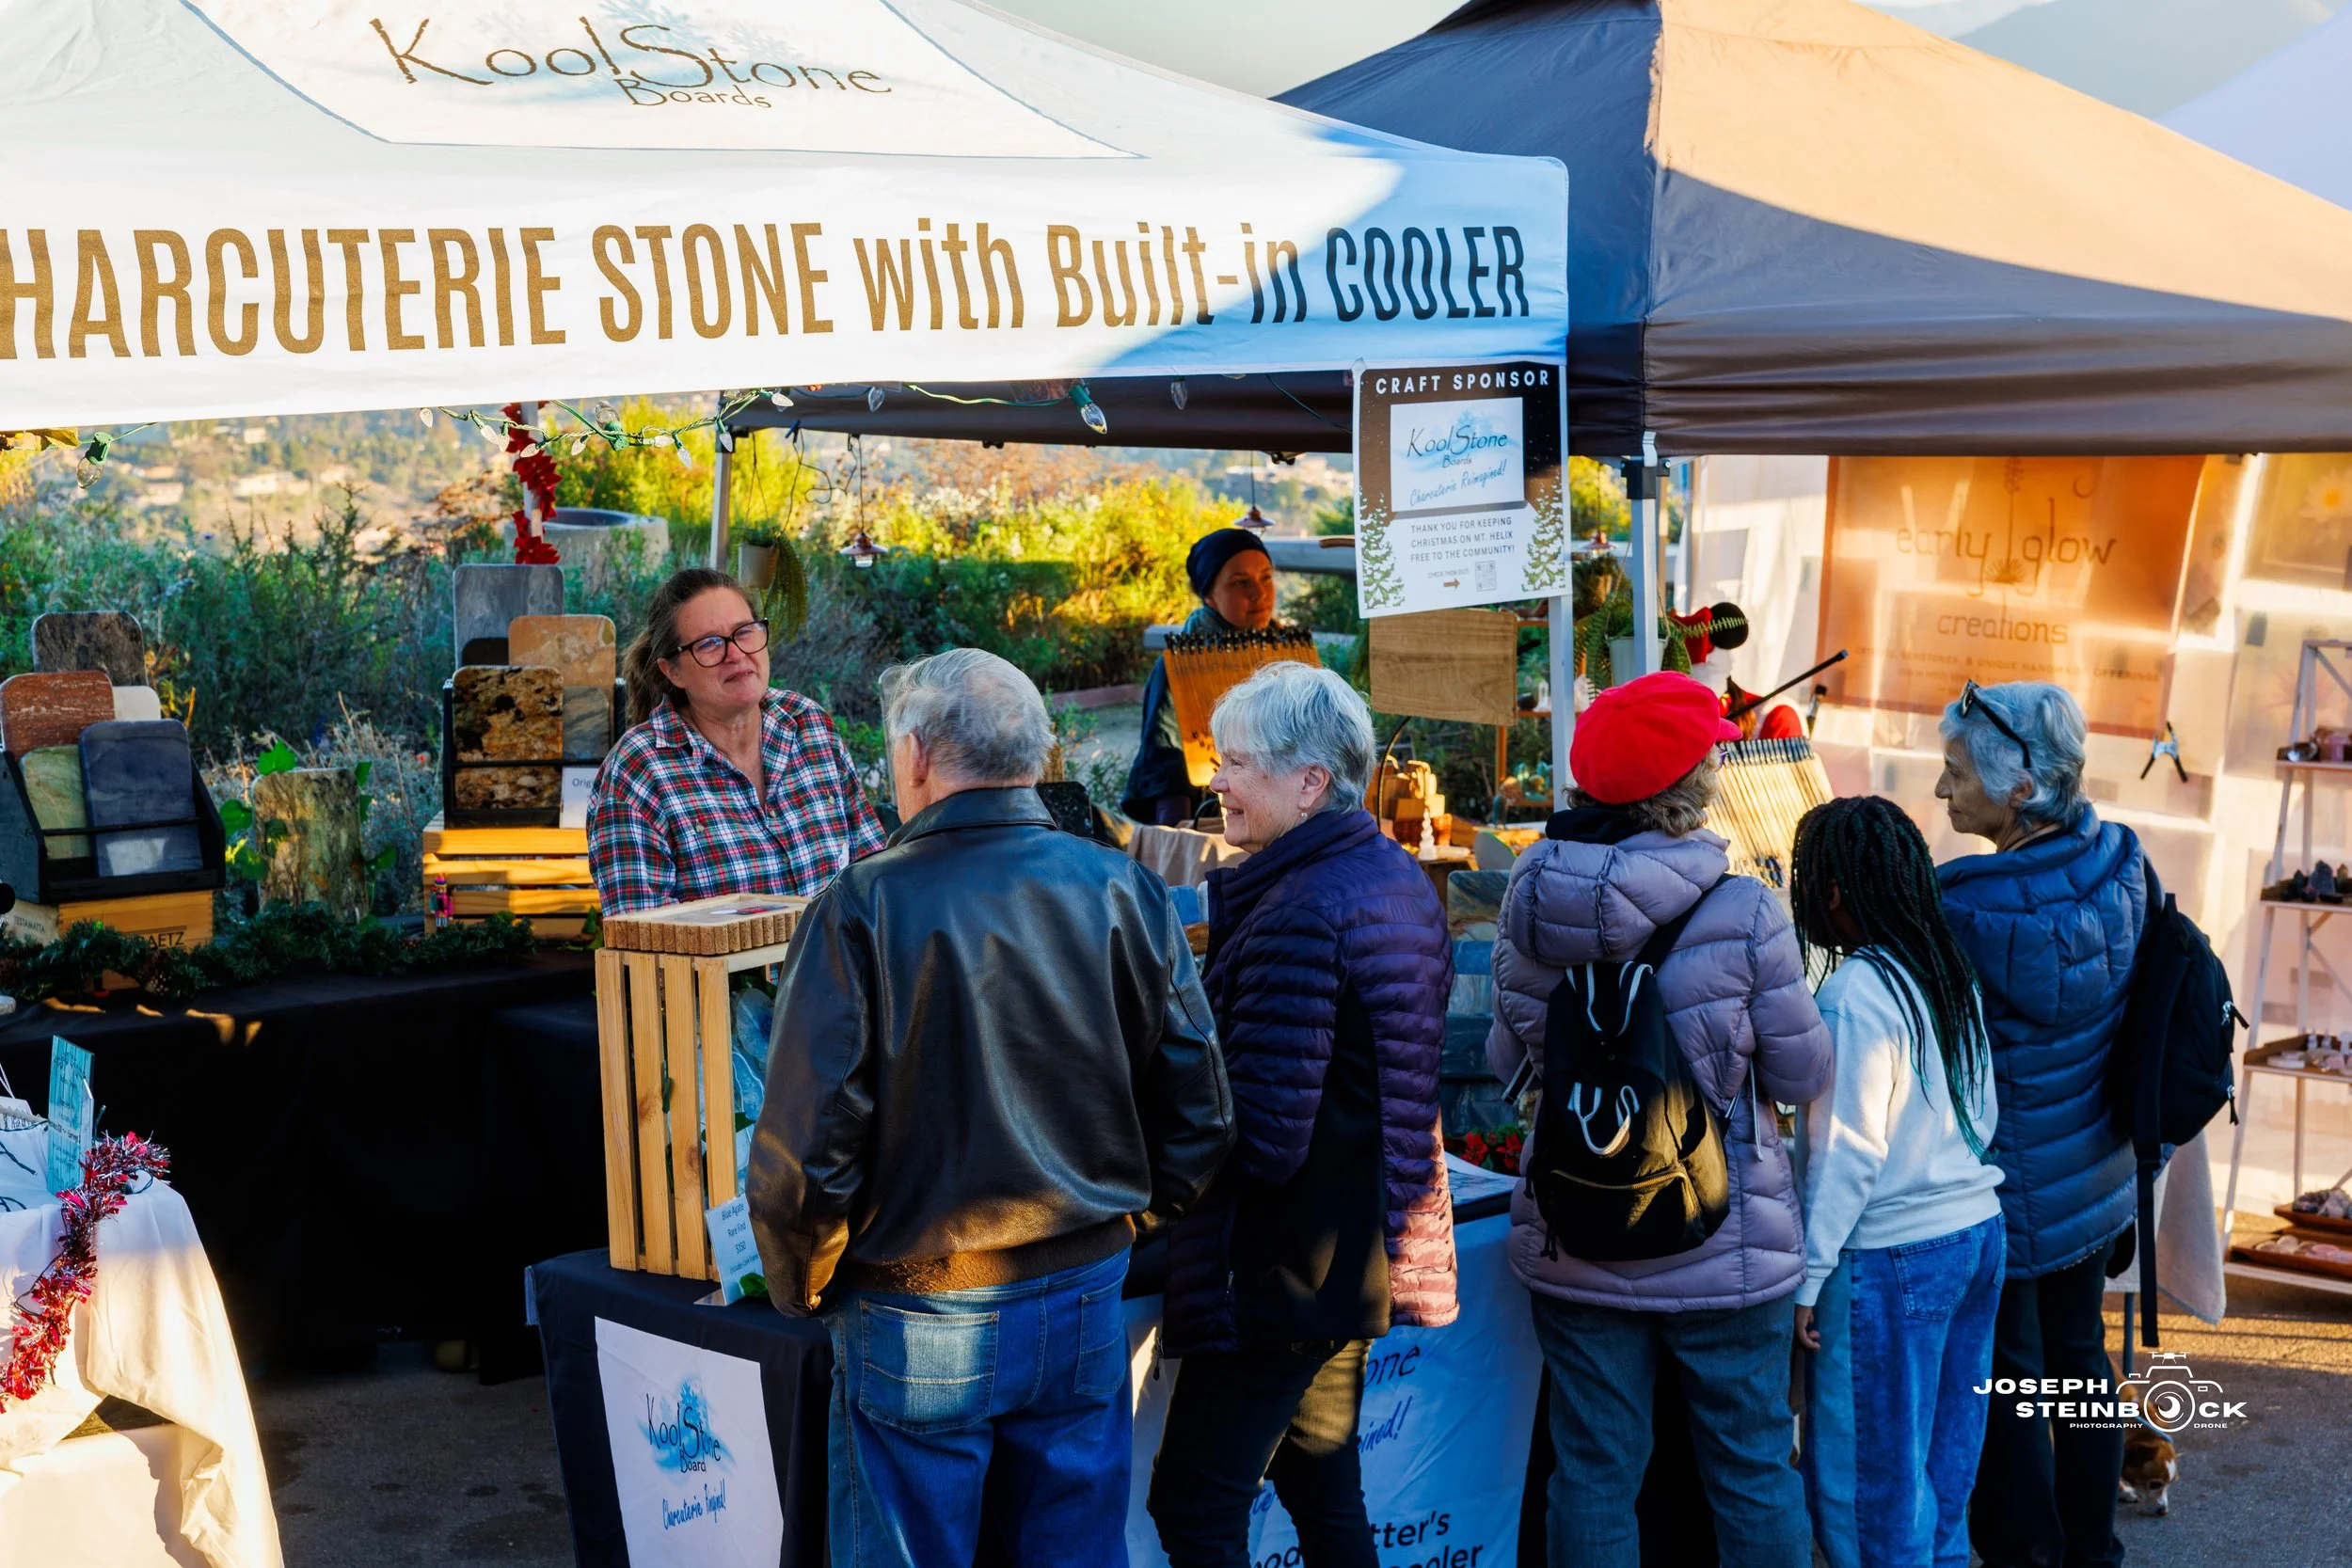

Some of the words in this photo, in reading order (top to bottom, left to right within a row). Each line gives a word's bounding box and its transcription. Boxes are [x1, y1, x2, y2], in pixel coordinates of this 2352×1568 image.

[369, 16, 892, 93] KoolStone
[613, 78, 772, 108] Boards
[0, 227, 566, 359] HARCUTERIE
[592, 222, 834, 342] STONE
[853, 217, 1024, 332] with
[1047, 222, 1307, 327] Built-in
[1326, 226, 1530, 322] COOLER
[1375, 375, 1440, 394] CRAFT
[1453, 370, 1549, 390] SPONSOR
[1406, 425, 1507, 456] KoolStone
[1441, 453, 1472, 468] Boards
[1460, 459, 1507, 489] Reimagined!
[1411, 523, 1438, 533] THANK
[1440, 522, 1457, 531] YOU
[1459, 520, 1475, 530] FOR
[1477, 516, 1512, 528] KEEPING
[1411, 535, 1457, 548] CHRISTMAS
[1460, 534, 1471, 544] ON
[1473, 532, 1486, 542] MT.
[1489, 531, 1513, 540] HELIX
[1410, 552, 1430, 562] FREE
[1433, 551, 1442, 561] TO
[1445, 549, 1460, 559] THE
[1462, 545, 1515, 558] COMMUNITY!
[1897, 499, 1992, 597] early
[2023, 498, 2118, 597] glow
[1937, 614, 2069, 644] creations
[722, 1209, 732, 1221] Blue
[731, 1203, 744, 1216] Agate
[727, 1228, 738, 1238] Rare
[738, 1222, 747, 1233] Find
[646, 1393, 721, 1461] KoolStone
